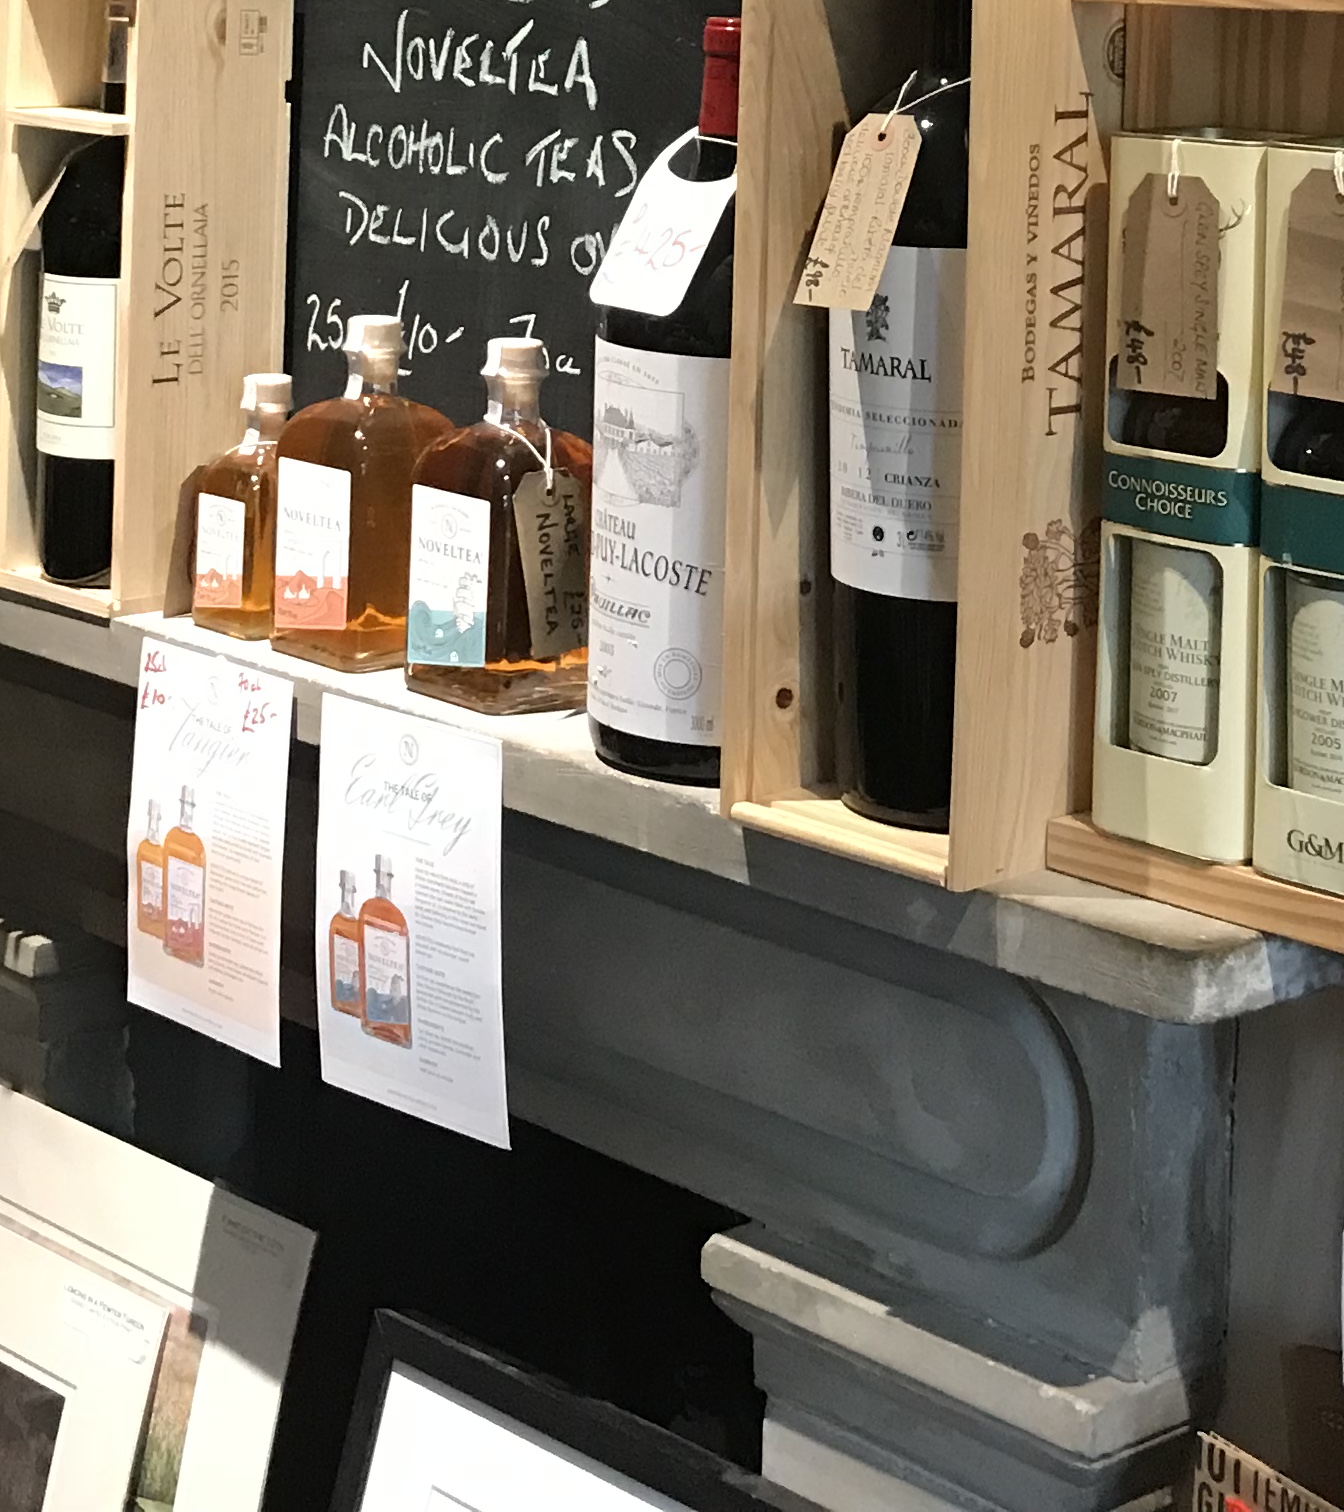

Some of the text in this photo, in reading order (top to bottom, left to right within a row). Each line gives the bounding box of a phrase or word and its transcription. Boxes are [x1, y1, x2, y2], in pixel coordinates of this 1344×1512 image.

[362, 9, 599, 110] NOVELTEA
[323, 103, 639, 199] ALCOHOLIC TEAS
[338, 190, 551, 268] DELICIOUS
[1026, 253, 1038, 269] Y
[1044, 90, 1096, 437] TAMARAL
[152, 191, 188, 389] LE VOLTE
[219, 257, 241, 313] 2015
[1021, 271, 1038, 384] BODEGAS
[840, 346, 932, 384] TAMARAL
[1124, 318, 1155, 385] £48-
[1281, 330, 1317, 395] £48-
[884, 472, 941, 489] CRIANZA
[1108, 470, 1229, 507] CONNOISSEURS
[283, 506, 342, 532] NOVELTEA
[891, 494, 933, 512] DUERO
[1134, 492, 1194, 520] CHOICE
[418, 536, 482, 565] NOVELTEA
[535, 512, 560, 636] NOVELTEA
[1149, 686, 1179, 703] 2007
[1311, 732, 1342, 751] 2005
[1286, 827, 1344, 866] G&M
